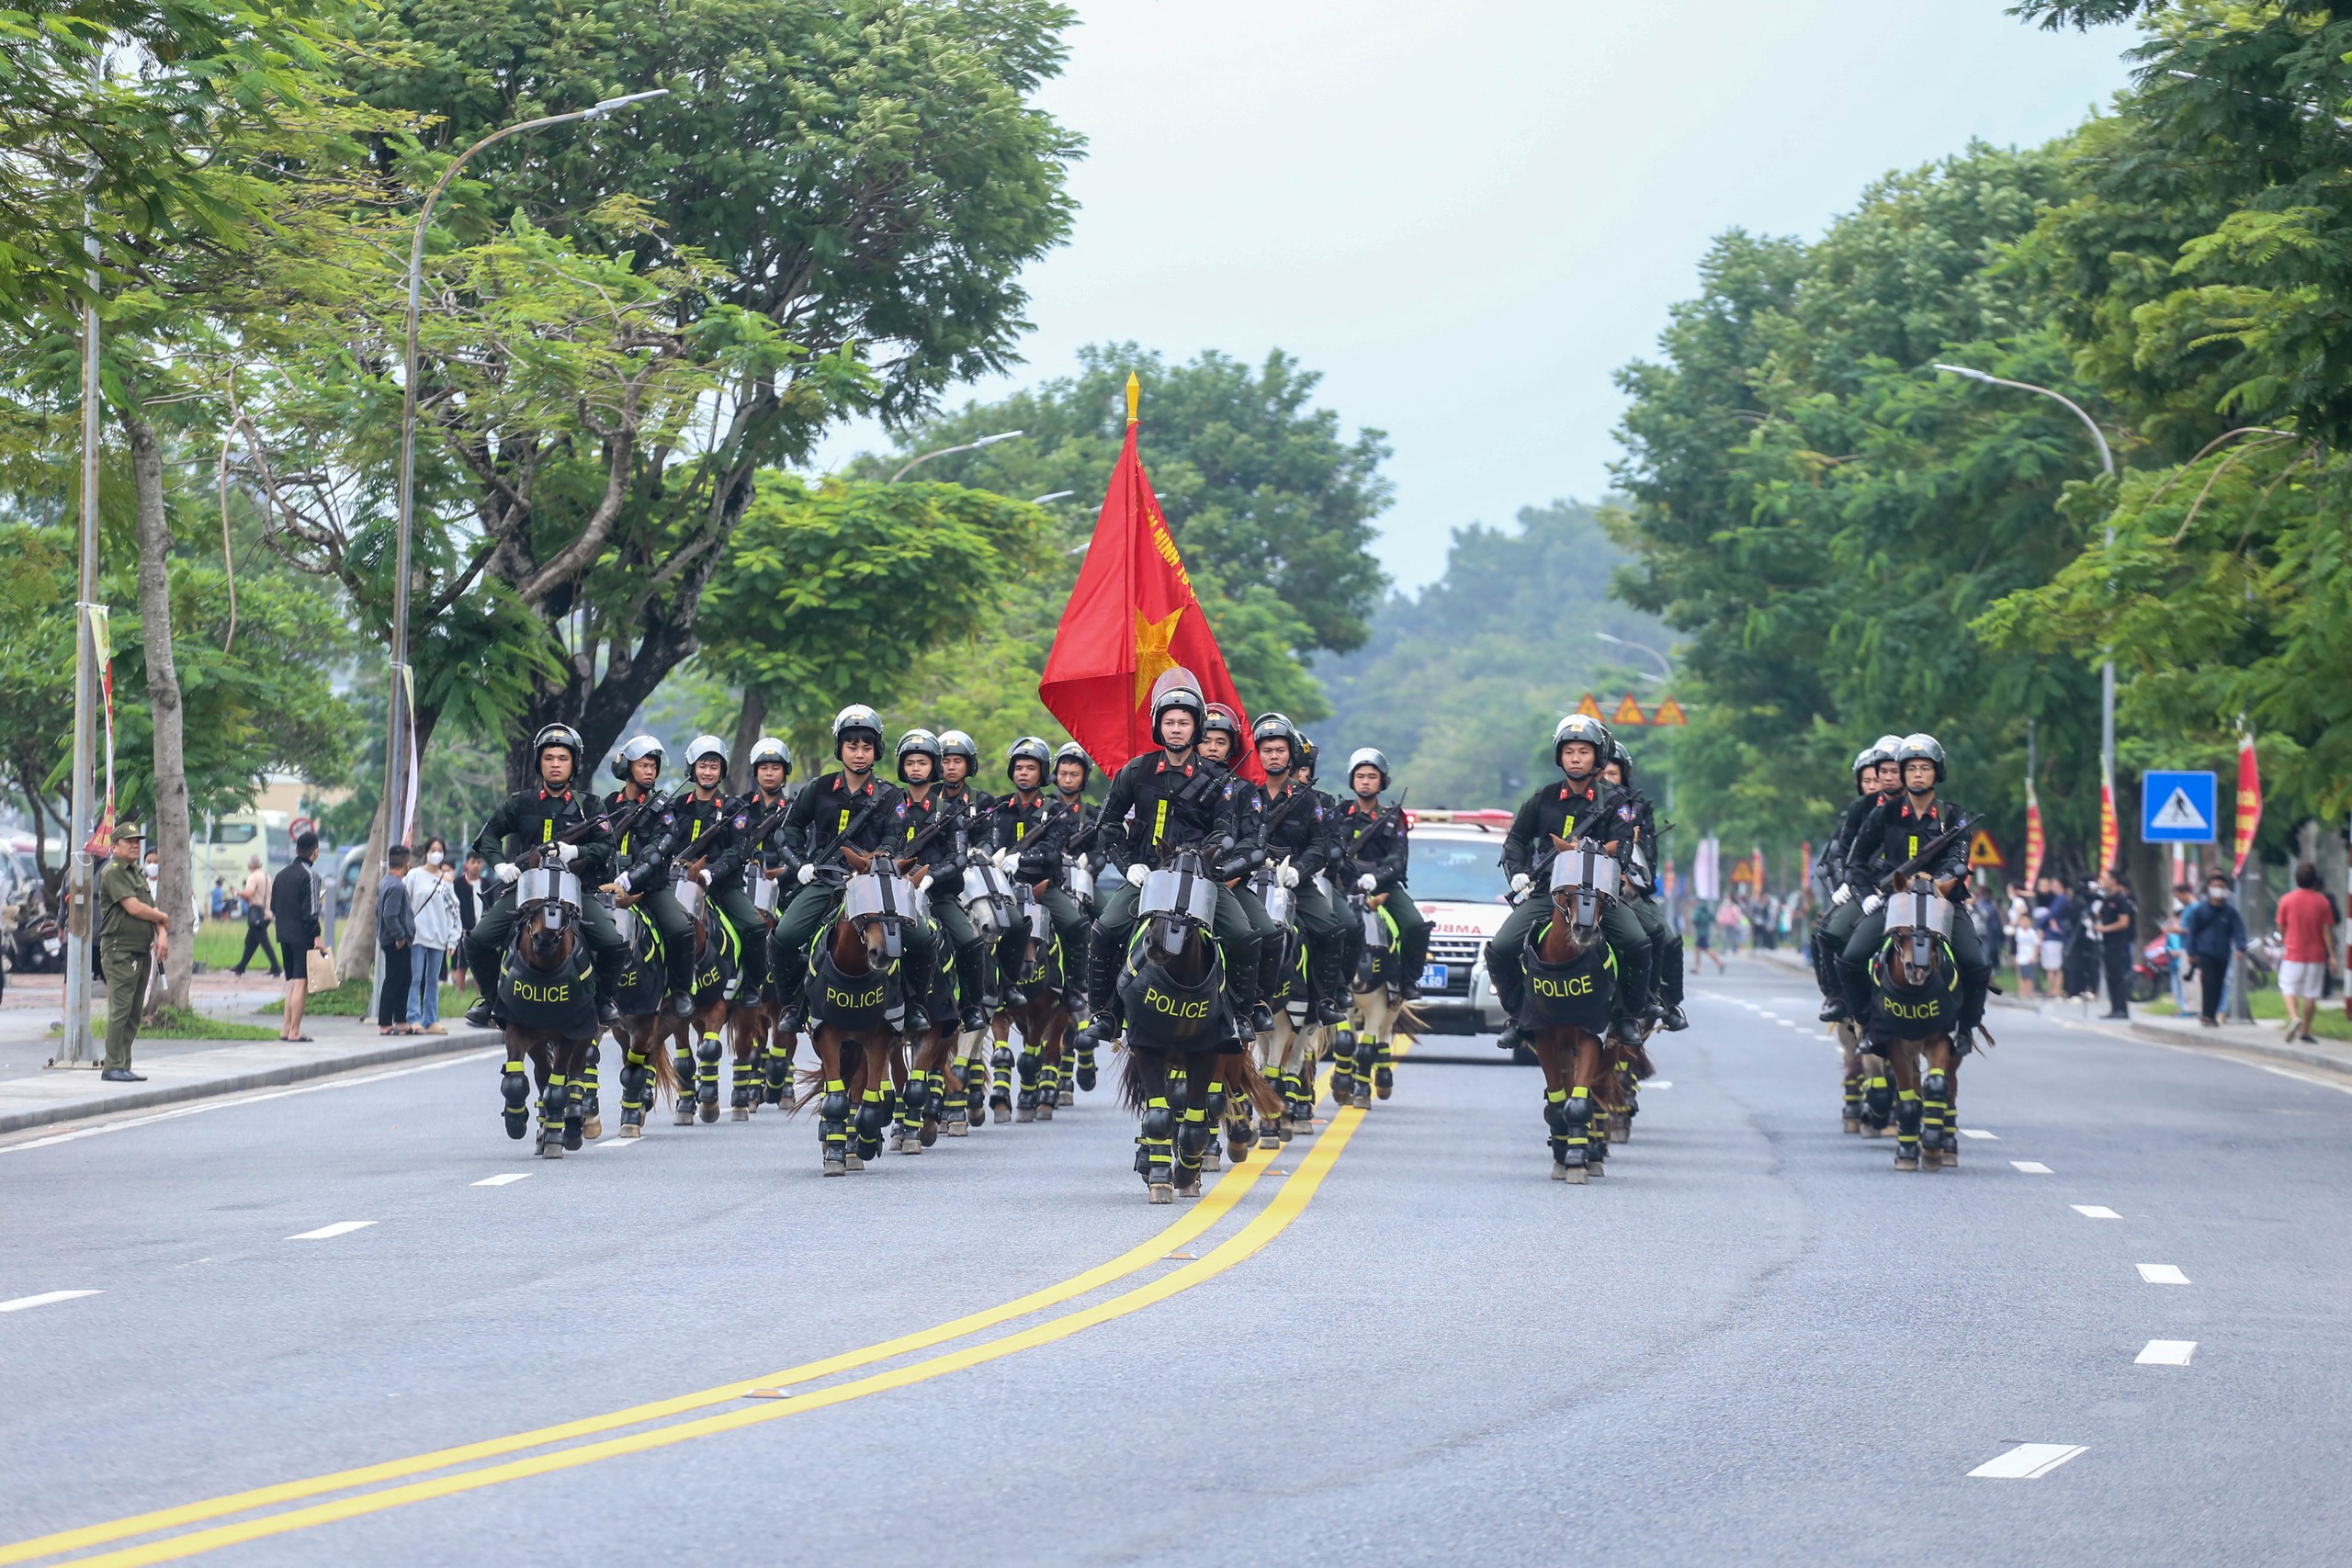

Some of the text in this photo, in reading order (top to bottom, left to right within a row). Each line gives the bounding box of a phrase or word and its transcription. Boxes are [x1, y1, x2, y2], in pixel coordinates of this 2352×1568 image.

[697, 965, 720, 989] ICE
[1533, 975, 1593, 998] POLICE
[514, 979, 569, 1002] POLICE
[827, 986, 884, 1008] POLICE
[1144, 987, 1210, 1019] POLICE
[1883, 996, 1940, 1019] POLICE
